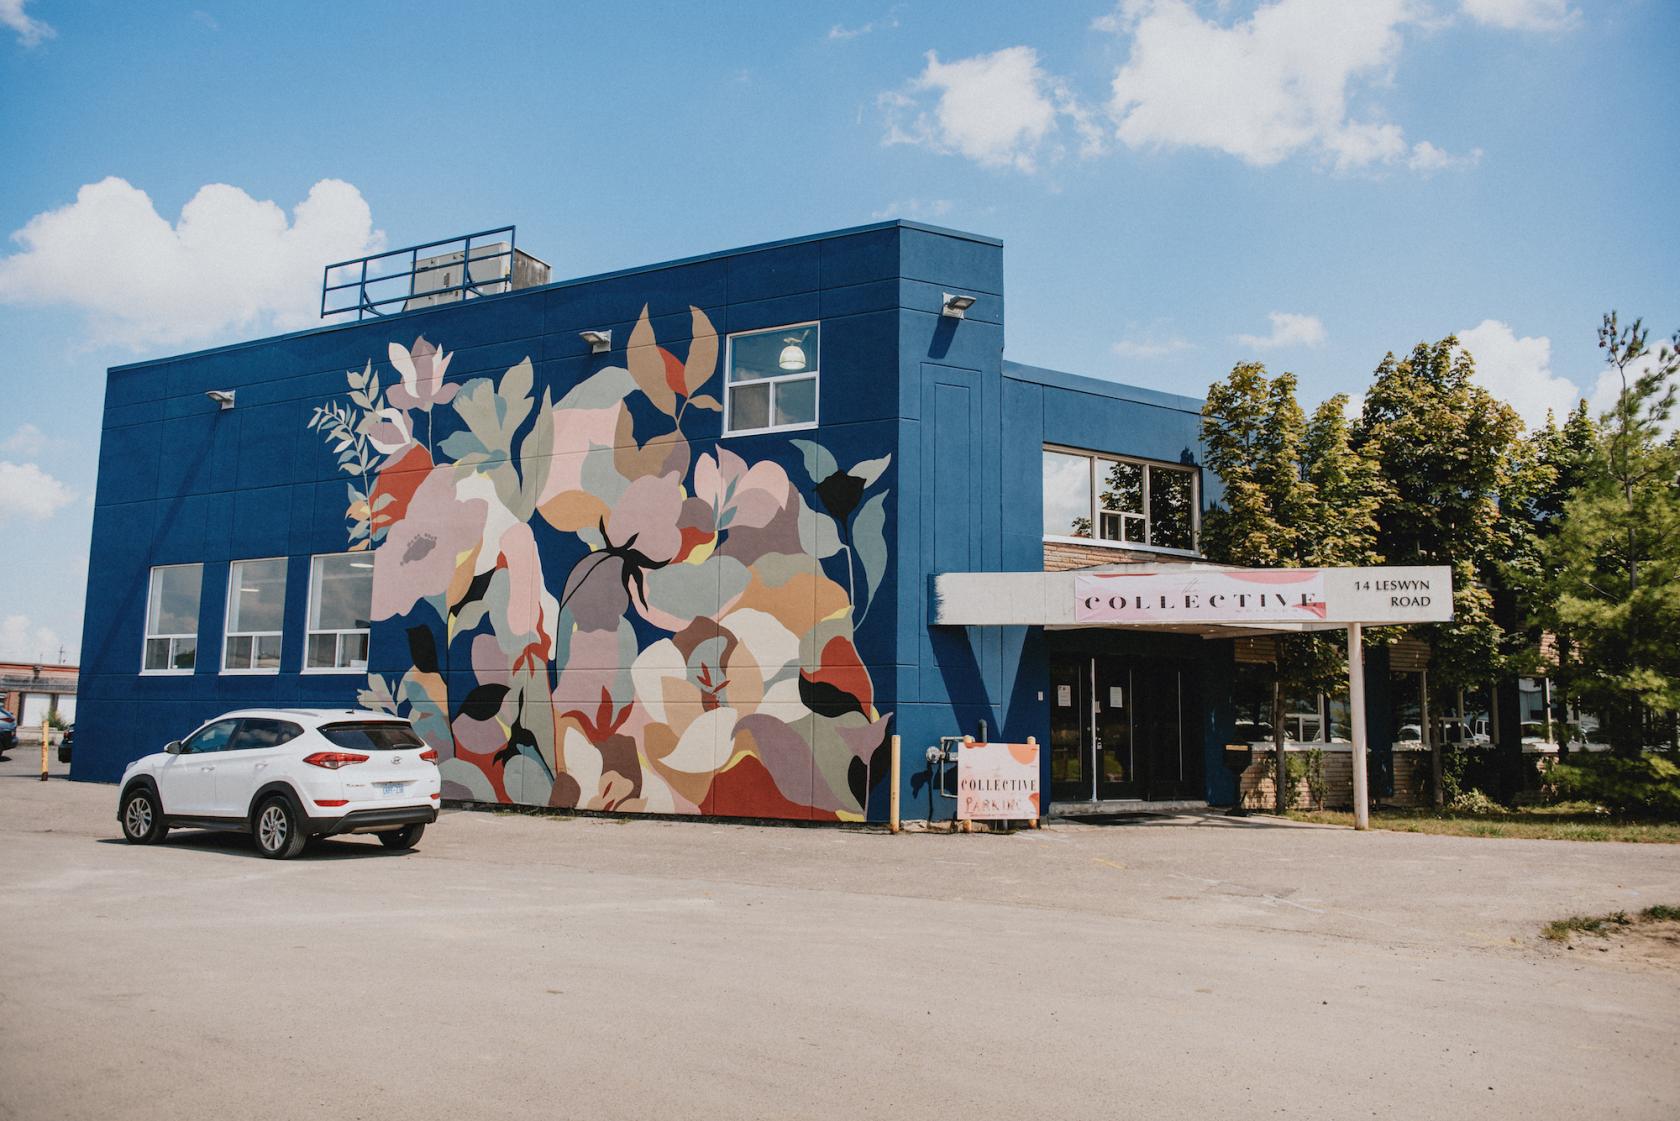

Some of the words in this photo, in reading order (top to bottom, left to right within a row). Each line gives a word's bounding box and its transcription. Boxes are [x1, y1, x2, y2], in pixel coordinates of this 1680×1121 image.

[1354, 580, 1370, 591] 14
[1375, 580, 1430, 591] LESWYN
[1084, 593, 1316, 610] COLLECTIVE
[1391, 596, 1431, 607] ROAD
[961, 779, 1036, 791] COLLECTIVE
